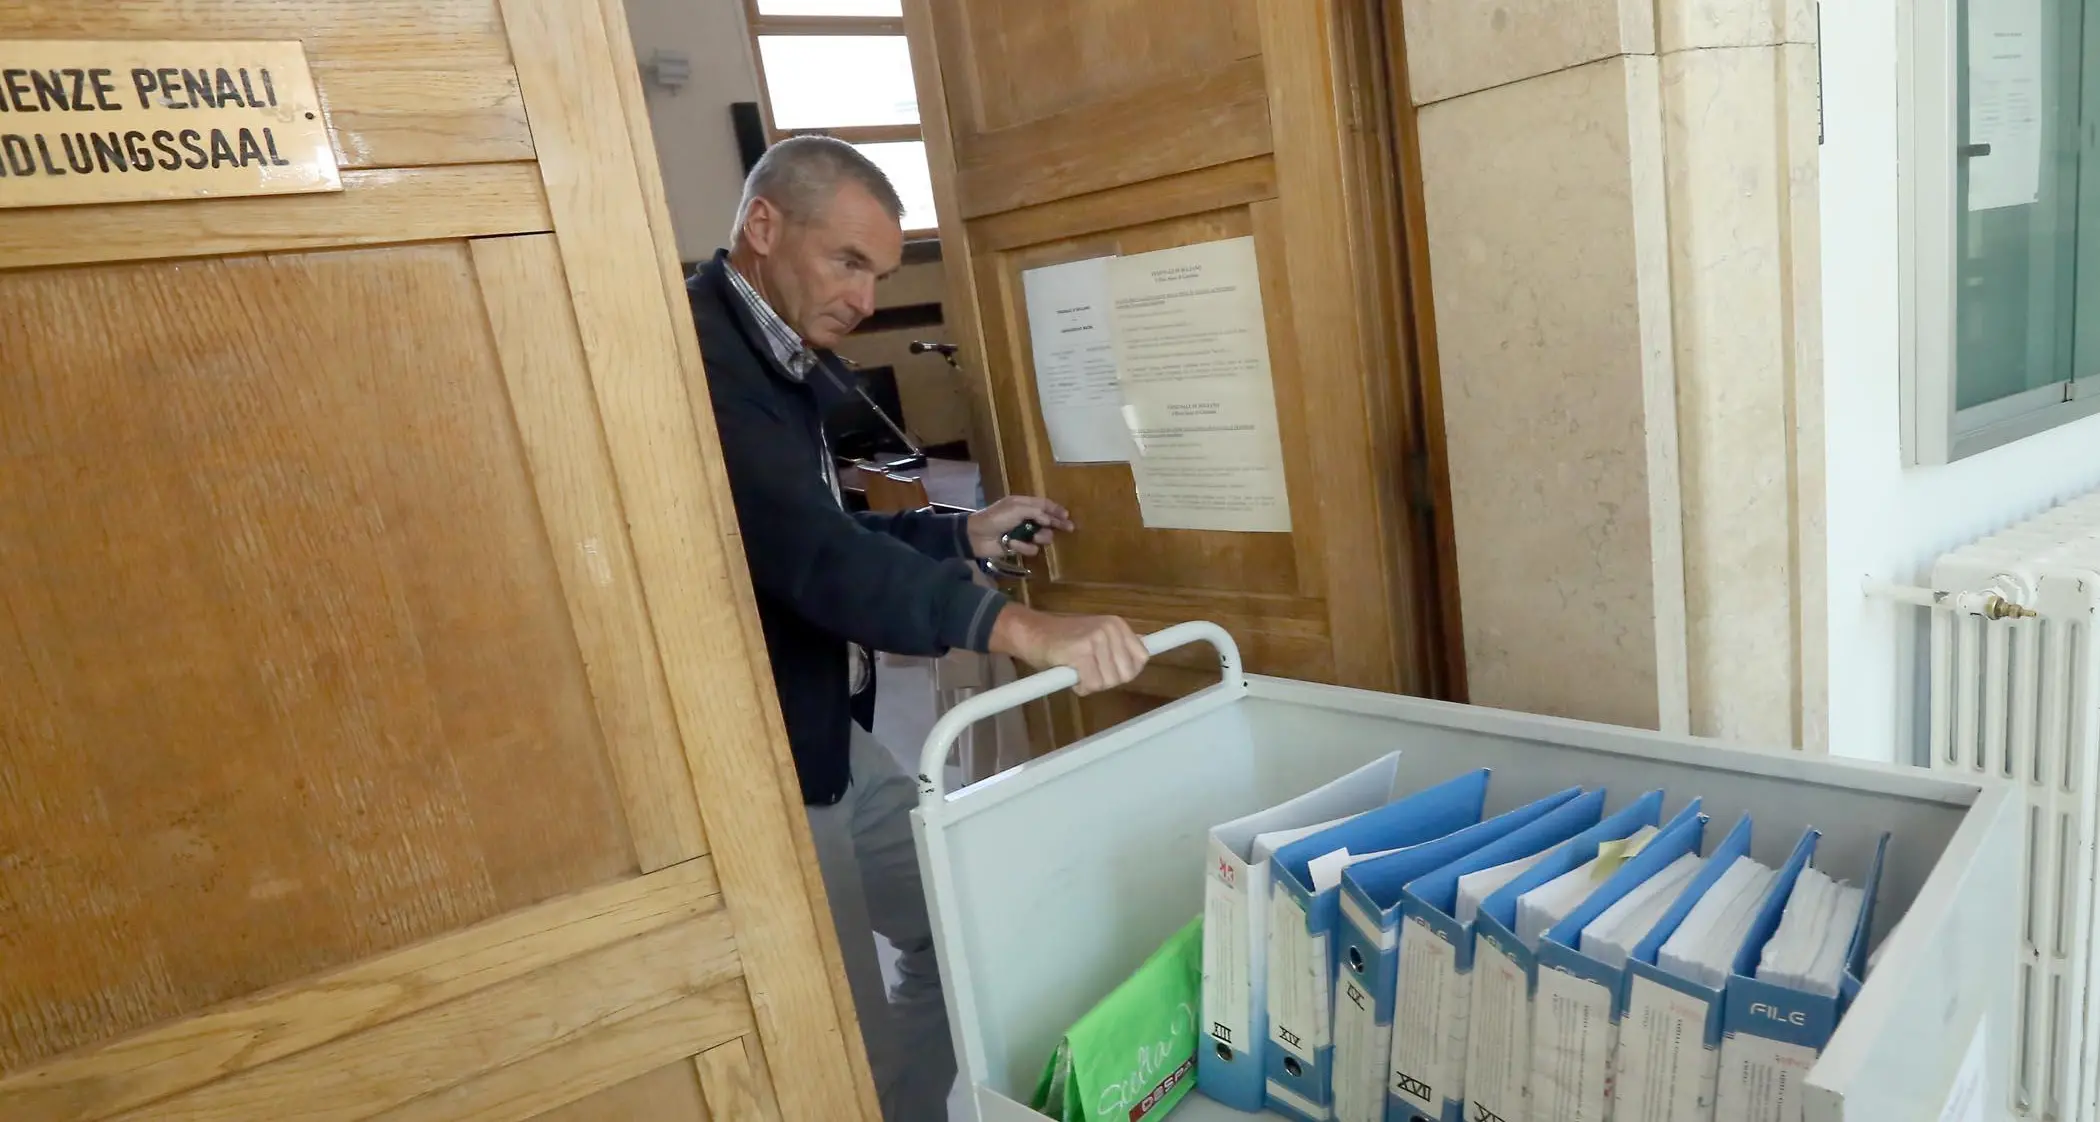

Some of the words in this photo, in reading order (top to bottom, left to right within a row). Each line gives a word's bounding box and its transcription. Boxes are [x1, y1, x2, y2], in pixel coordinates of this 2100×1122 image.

[131, 67, 277, 110] PENALI
[0, 127, 290, 177] DLUNGSSAAL
[1750, 1002, 1807, 1026] FILE
[1278, 1024, 1303, 1051] XIV
[1140, 1052, 1196, 1113] DESPA
[1395, 1070, 1432, 1103] XVII
